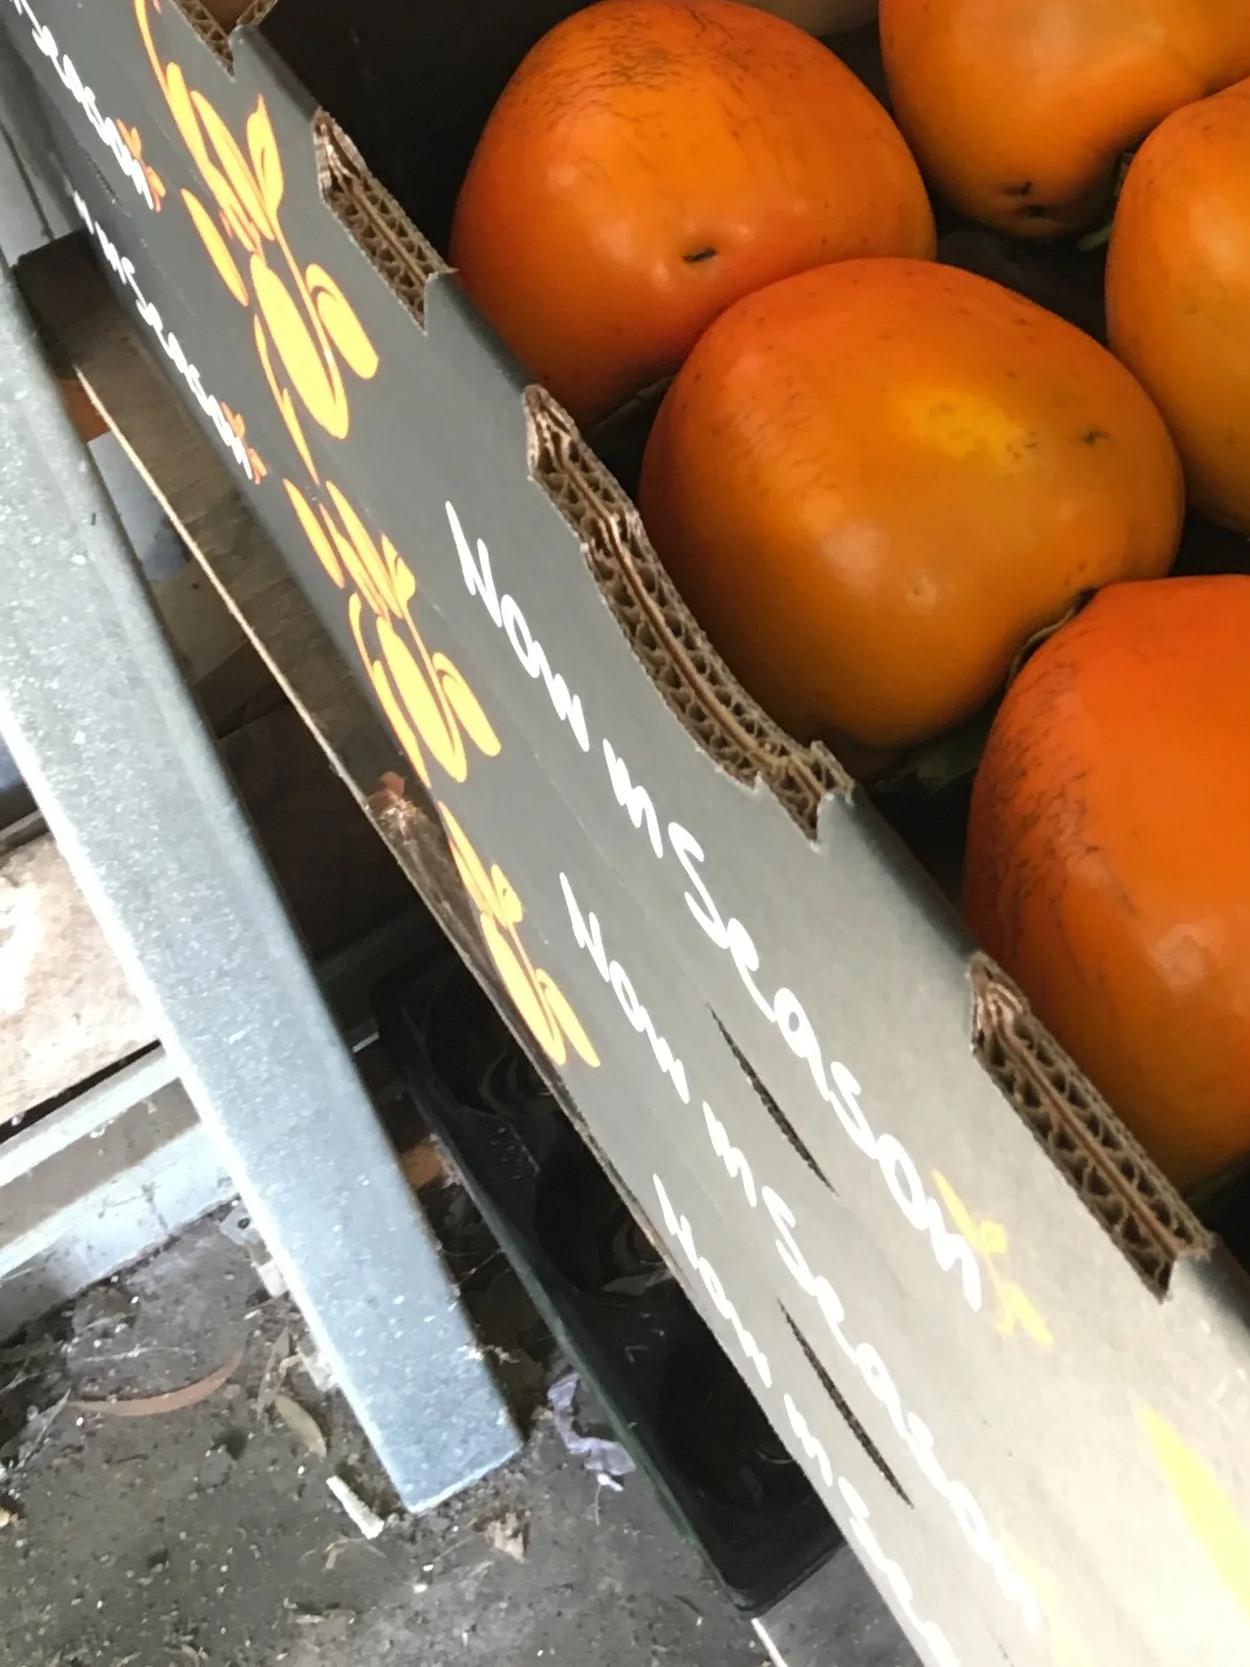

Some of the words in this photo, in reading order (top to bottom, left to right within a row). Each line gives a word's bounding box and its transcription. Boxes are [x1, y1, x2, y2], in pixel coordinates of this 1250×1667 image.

[444, 500, 590, 752] Now
[668, 821, 982, 1313] Season
[558, 871, 691, 1105] Now
